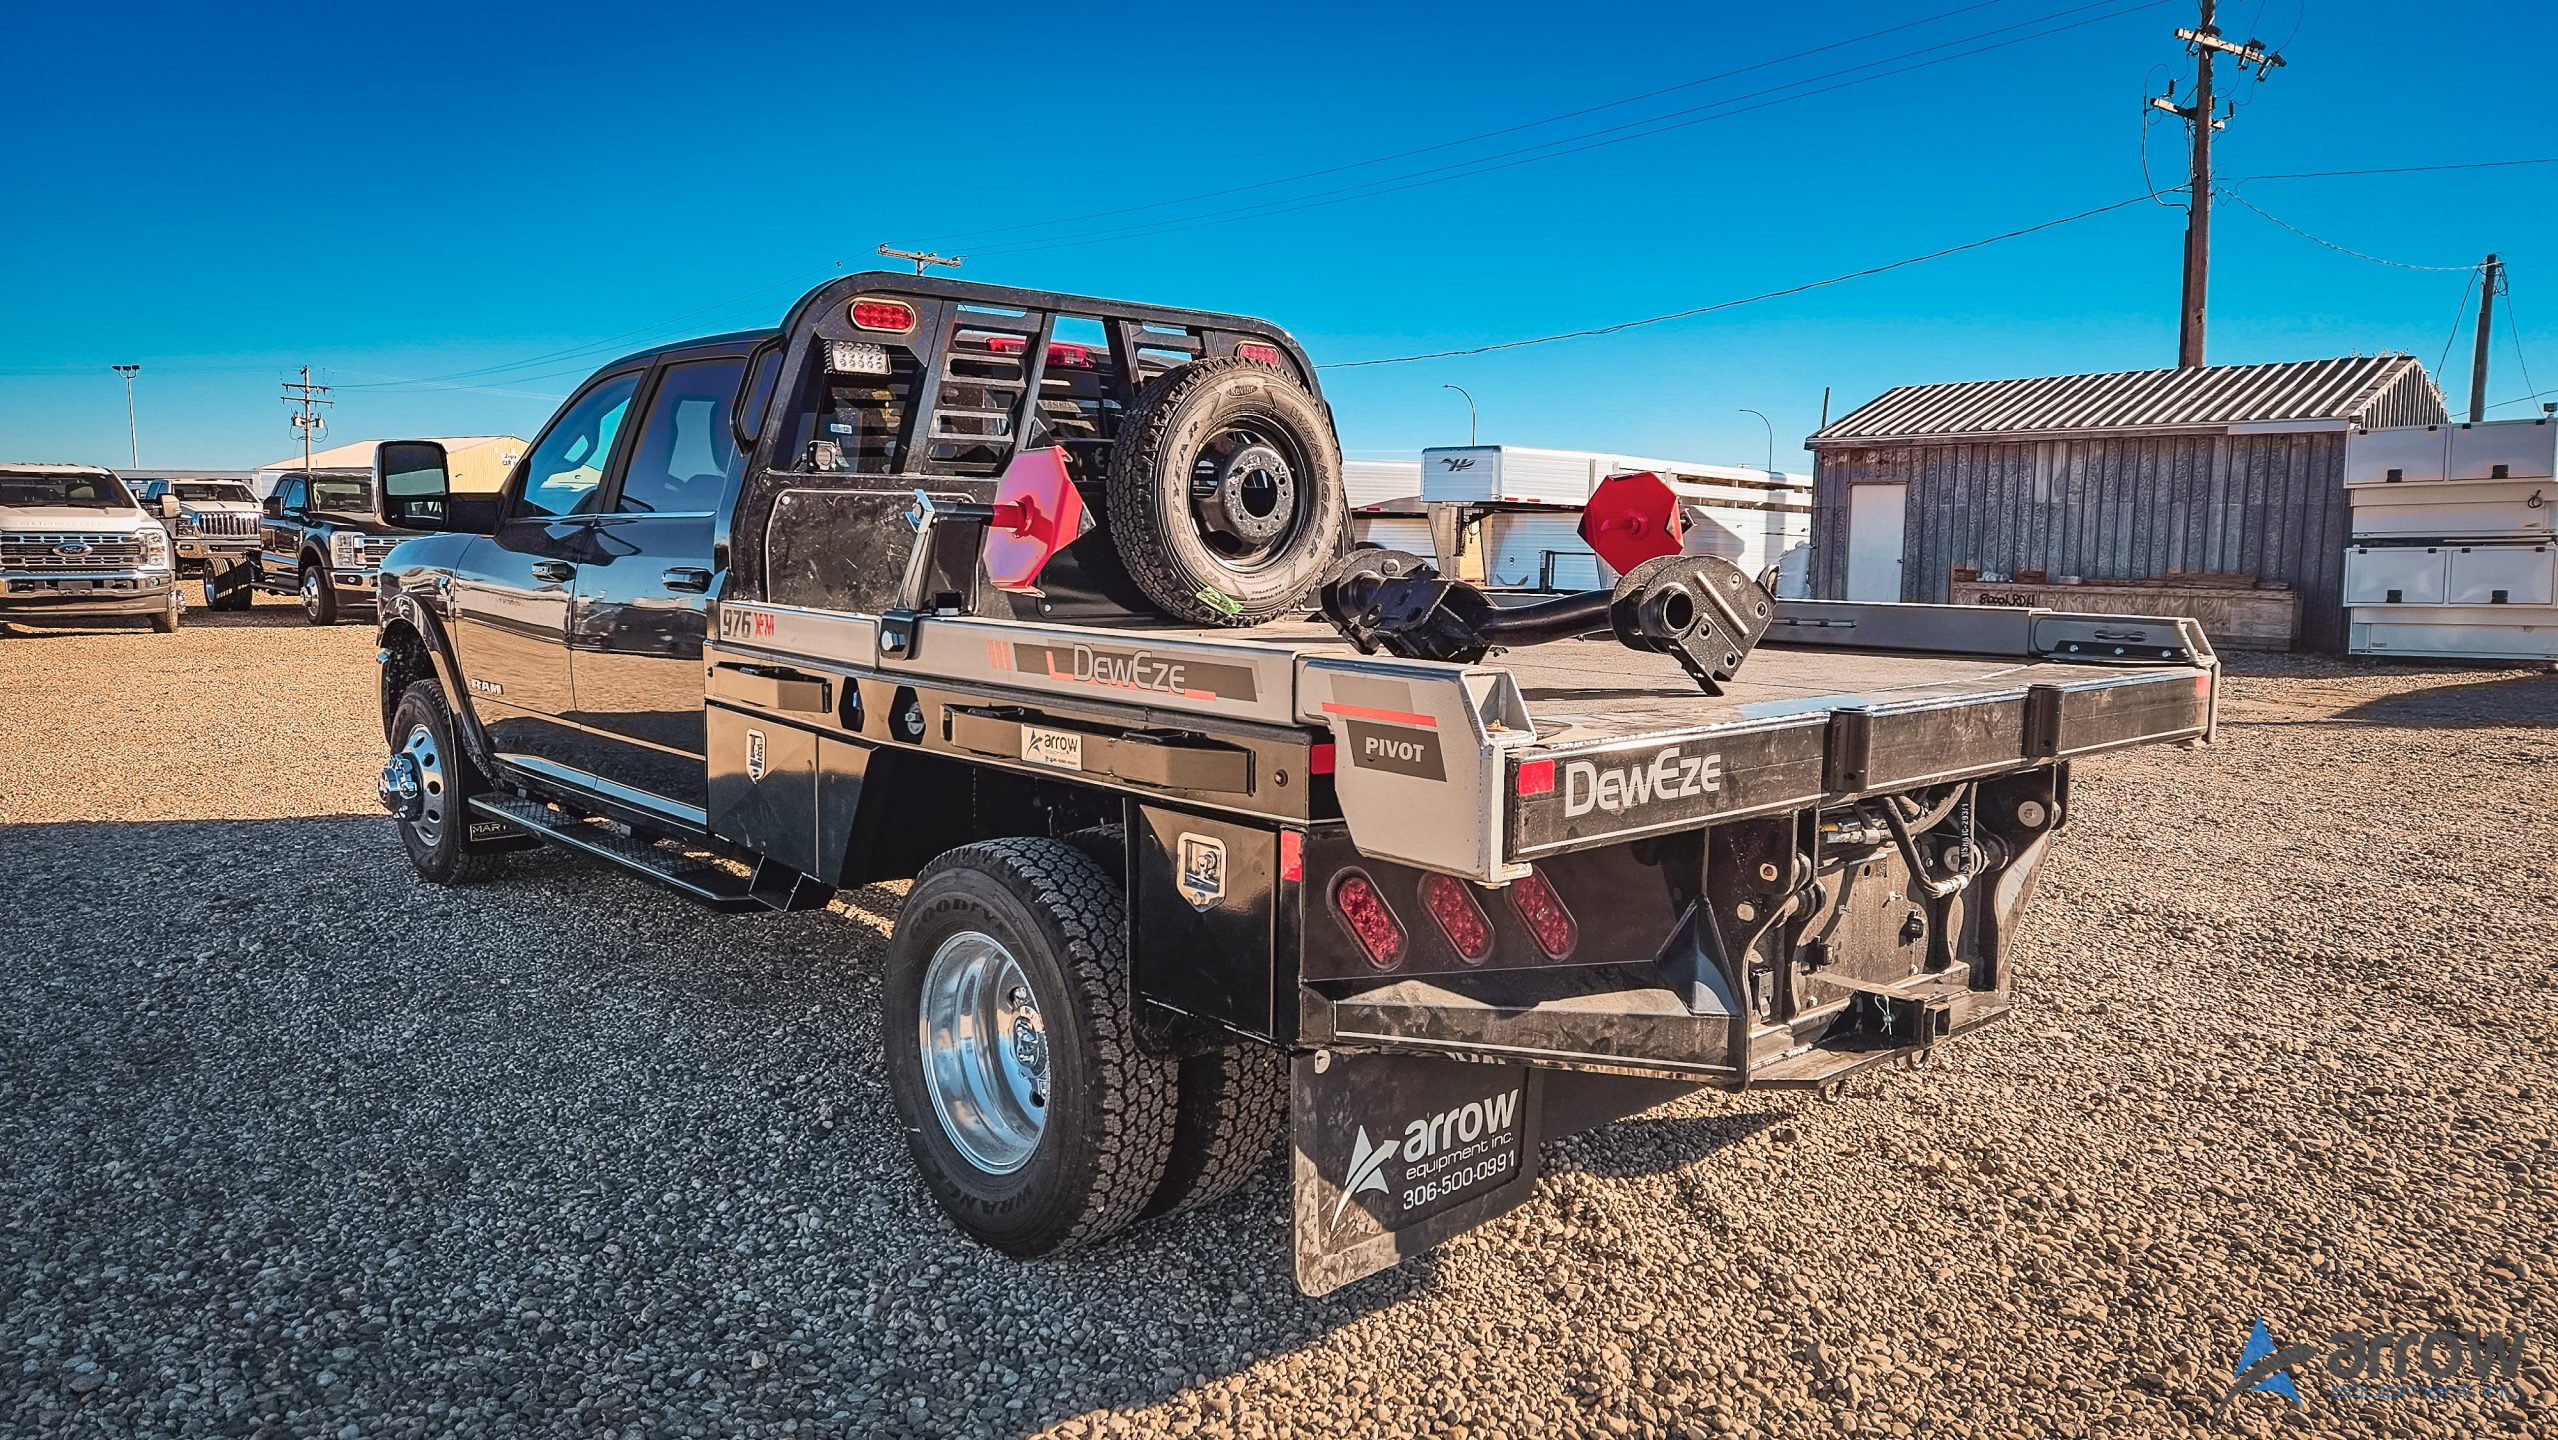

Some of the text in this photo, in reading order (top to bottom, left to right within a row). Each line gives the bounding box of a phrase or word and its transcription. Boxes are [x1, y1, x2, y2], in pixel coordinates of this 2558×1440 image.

[1230, 385, 1254, 396] Kevlar
[723, 609, 751, 638] 976
[471, 678, 504, 695] RAM
[1073, 643, 1185, 694] DewEze
[1044, 734, 1078, 752] arrow
[1365, 736, 1424, 762] PIVOT
[1565, 745, 1721, 817] DewEze
[1403, 1089, 1519, 1163] arrow
[1406, 1132, 1514, 1180] equipment inc.
[1403, 1149, 1515, 1210] 306-500-0991
